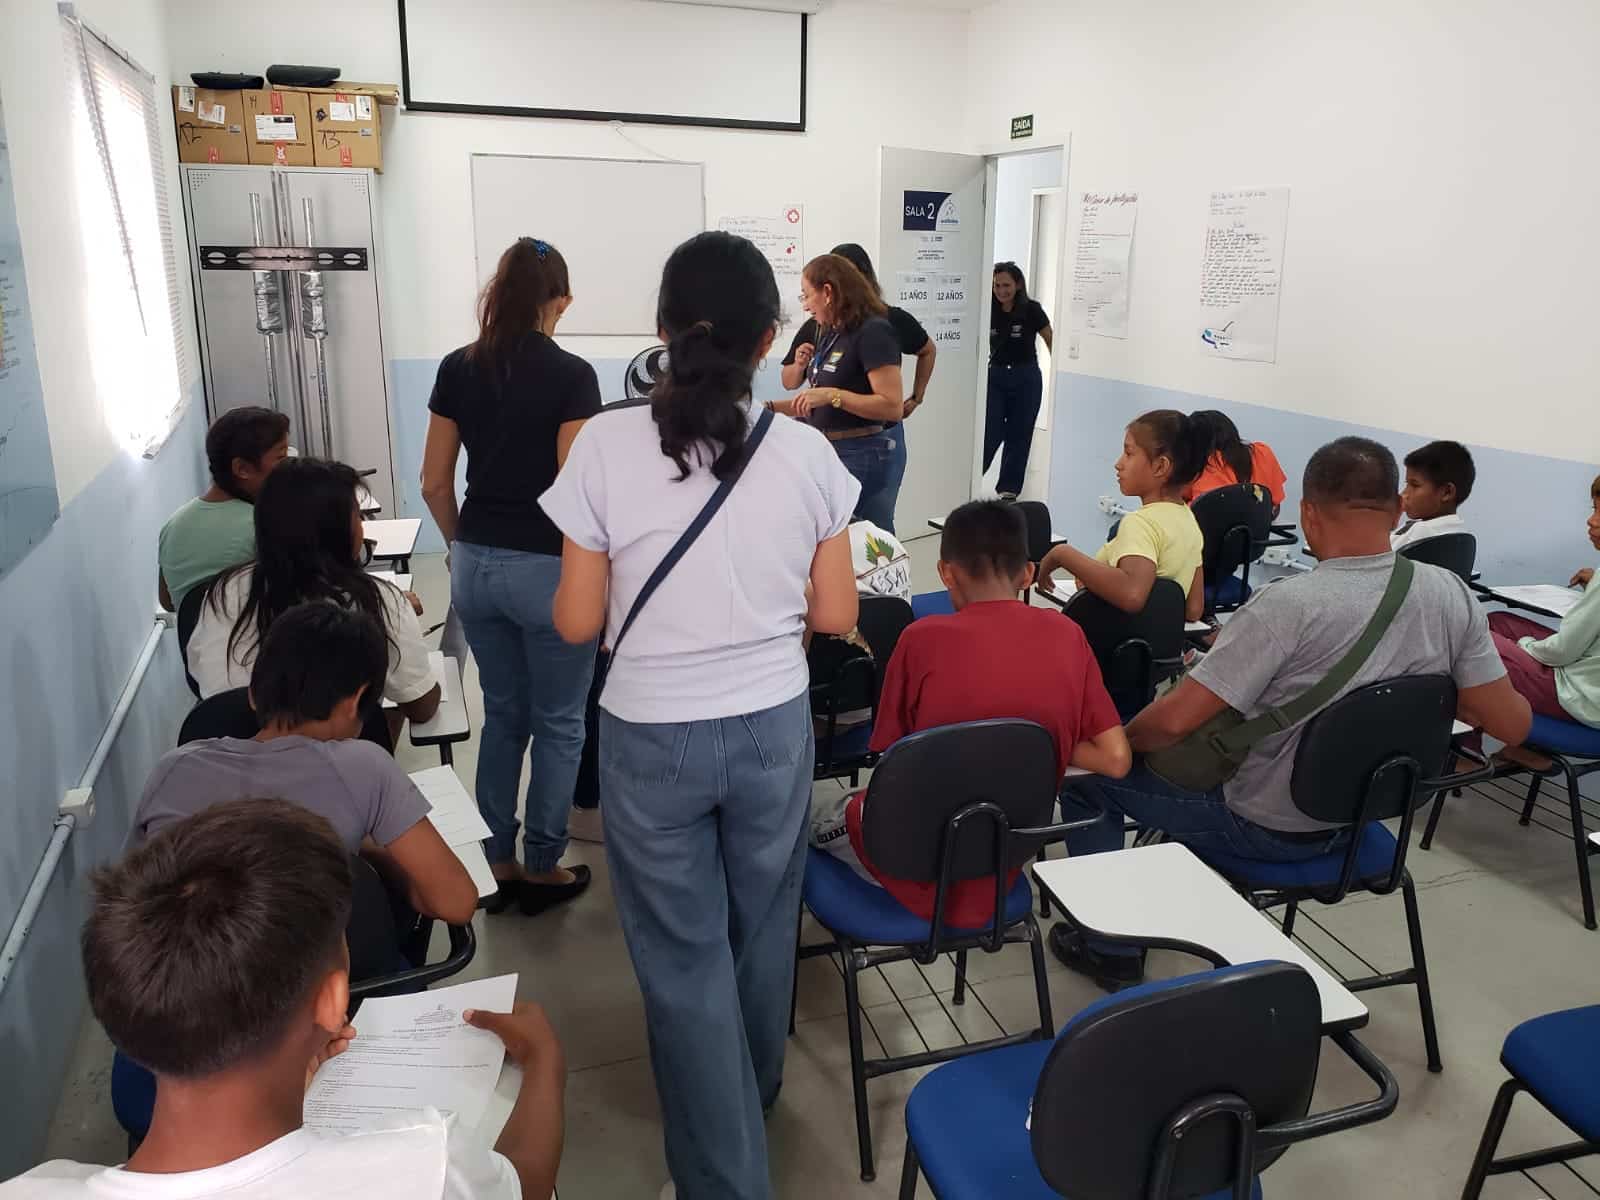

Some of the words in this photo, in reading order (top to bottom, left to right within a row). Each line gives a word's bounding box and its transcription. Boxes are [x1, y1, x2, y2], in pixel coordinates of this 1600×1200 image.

[905, 205, 925, 217] SALA
[927, 202, 936, 220] 2
[900, 291, 908, 301] 11
[909, 290, 928, 301] AÑOS
[937, 291, 945, 301] 12
[945, 290, 964, 301] AÑOS
[936, 332, 943, 342] 14
[944, 330, 961, 341] AÑOS
